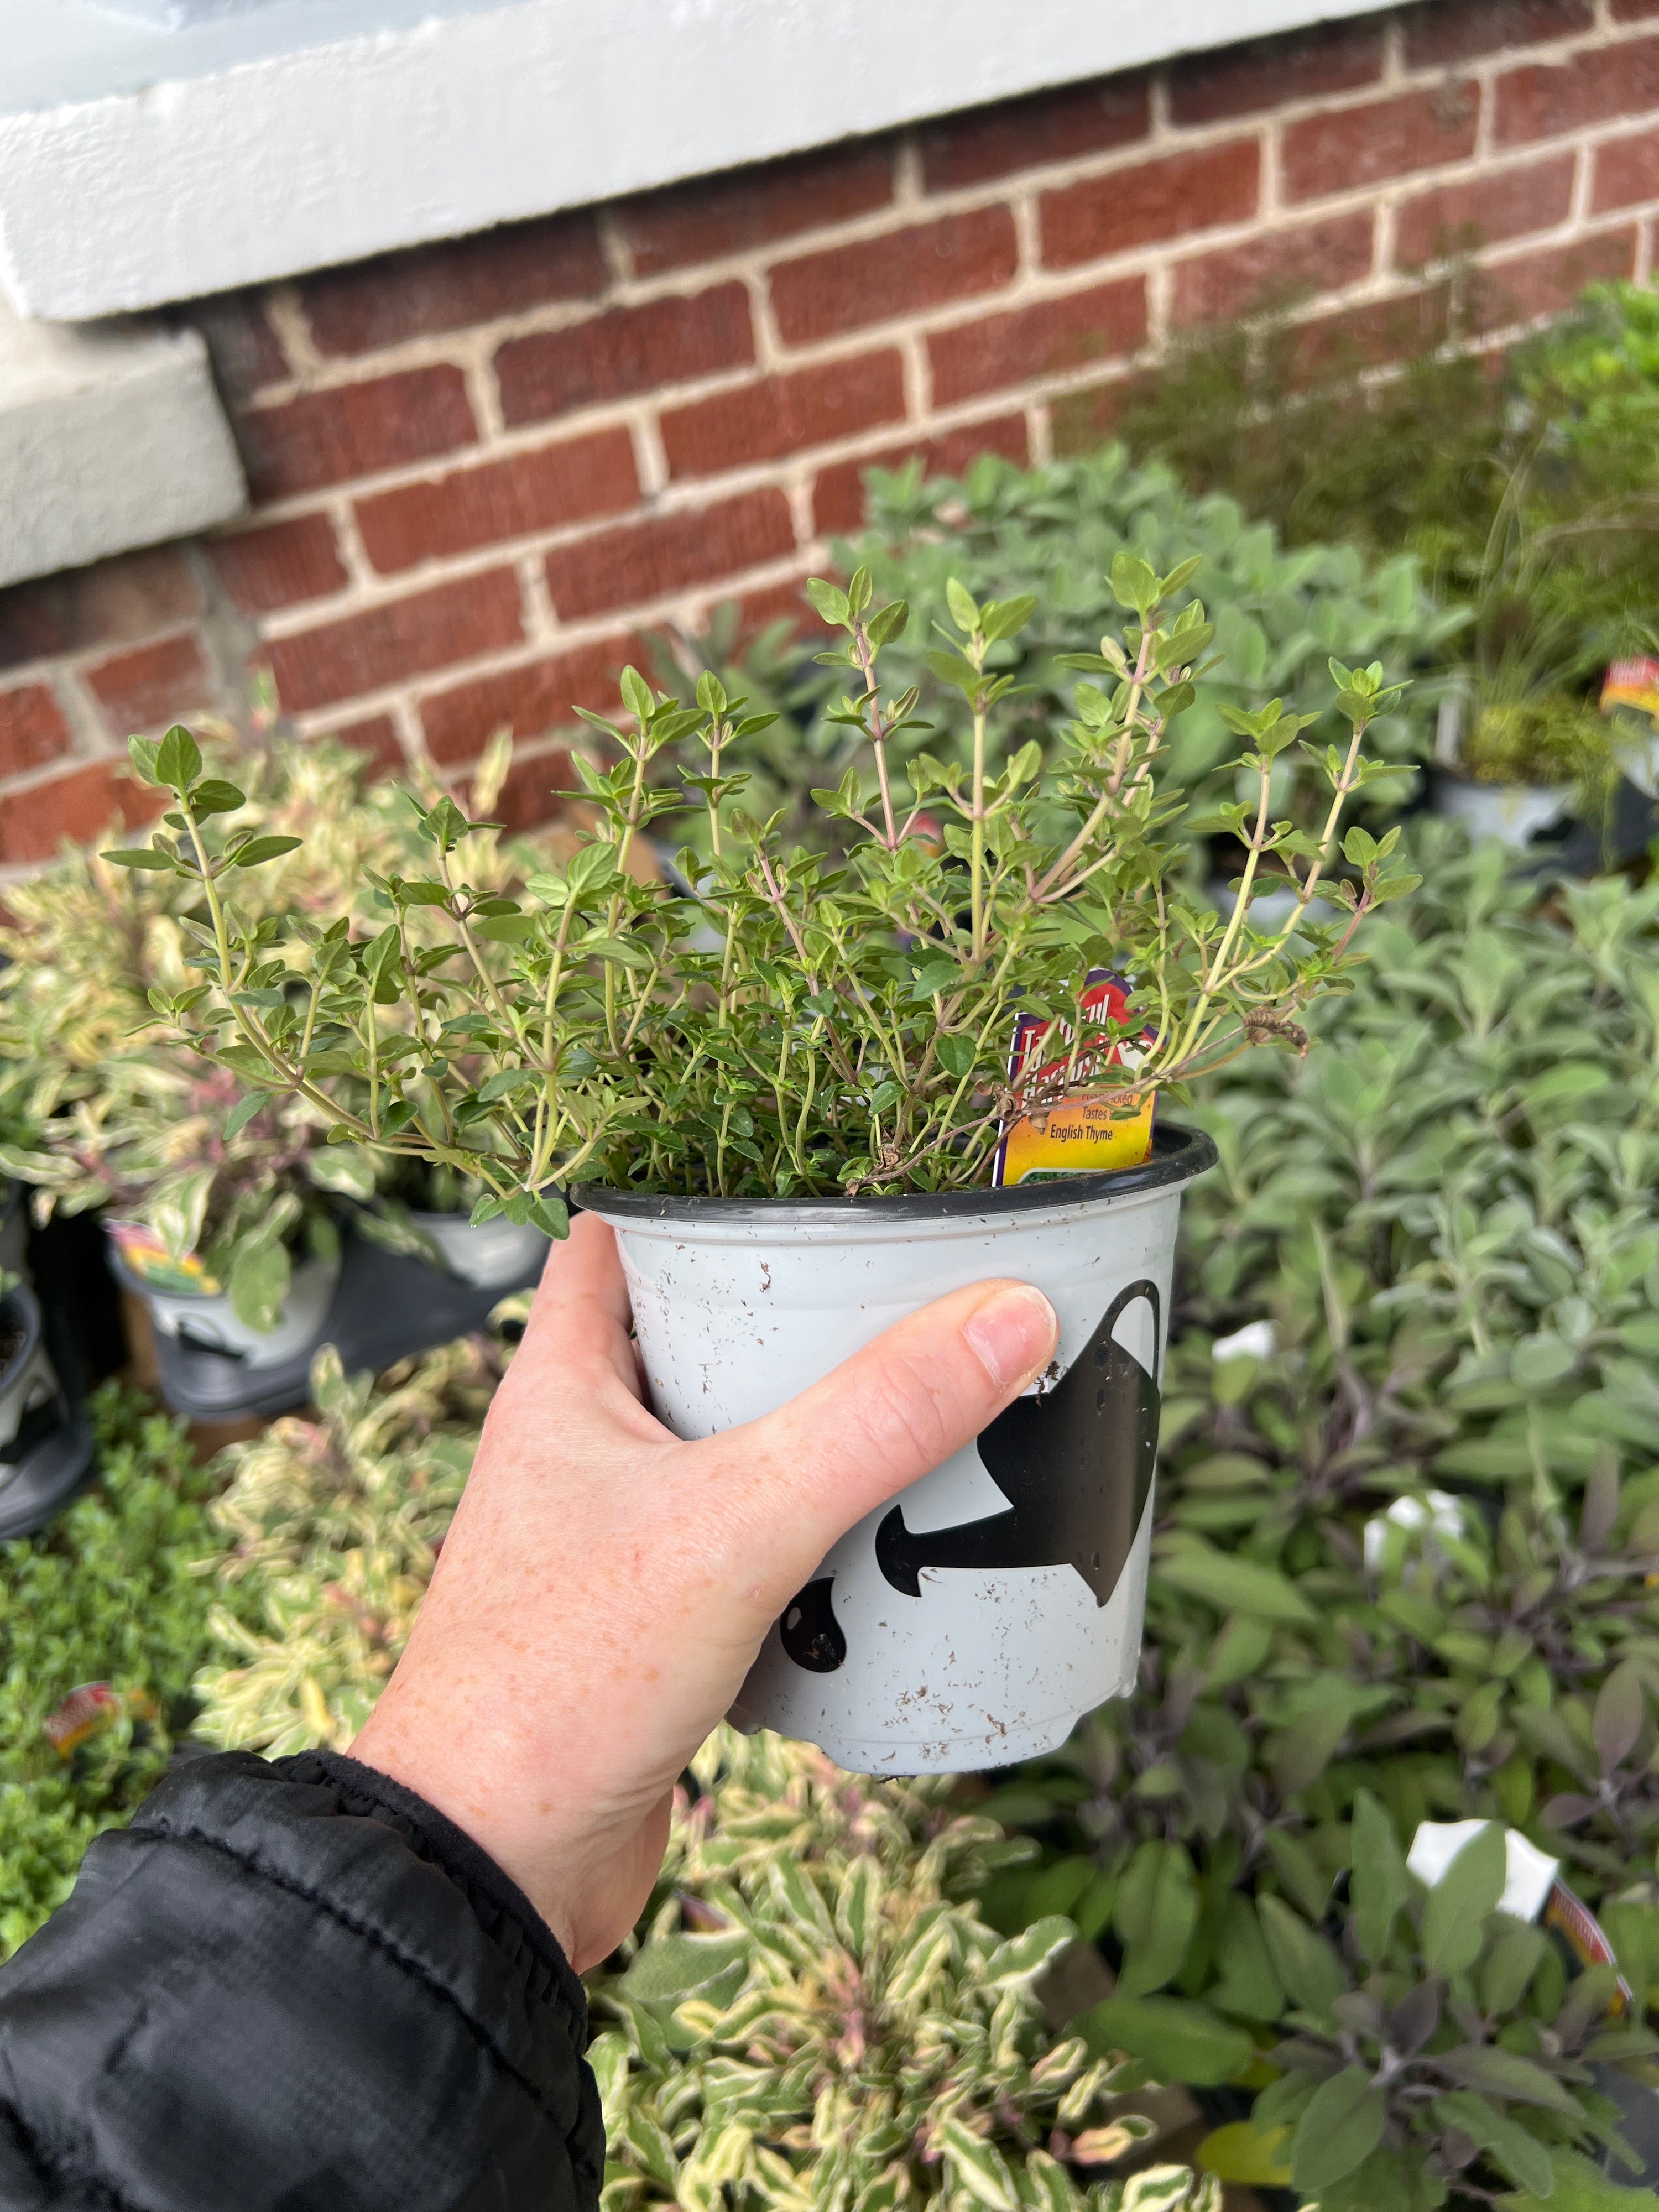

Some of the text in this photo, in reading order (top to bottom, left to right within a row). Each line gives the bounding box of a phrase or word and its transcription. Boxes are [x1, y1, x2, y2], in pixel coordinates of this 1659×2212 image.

[1082, 1106, 1107, 1120] Tastes
[1050, 1124, 1113, 1144] English Thyme
